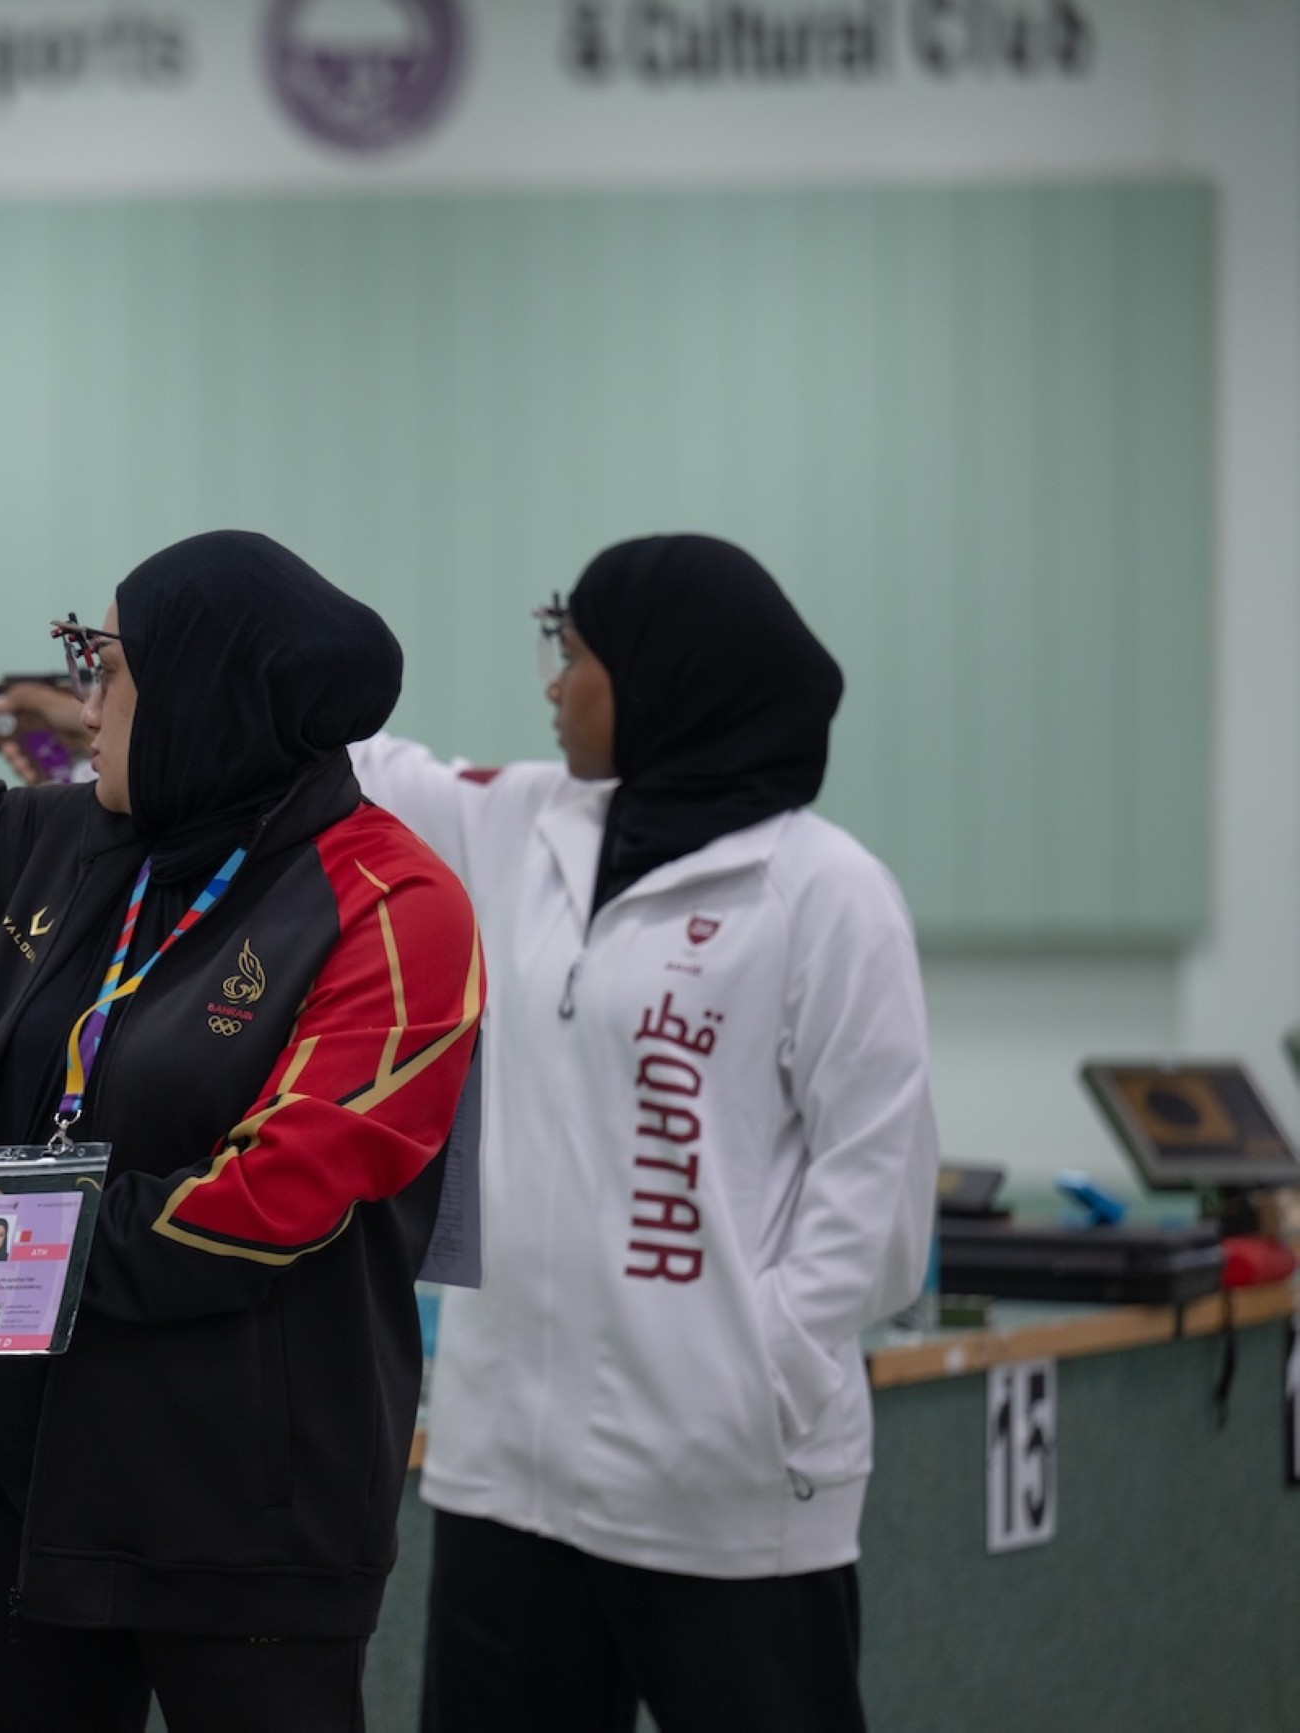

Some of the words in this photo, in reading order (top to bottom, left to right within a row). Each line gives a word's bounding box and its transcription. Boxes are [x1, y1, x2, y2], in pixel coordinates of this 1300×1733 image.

[634, 992, 723, 1056] قطر
[625, 1055, 706, 1285] QATAR
[989, 1369, 1052, 1537] 15
